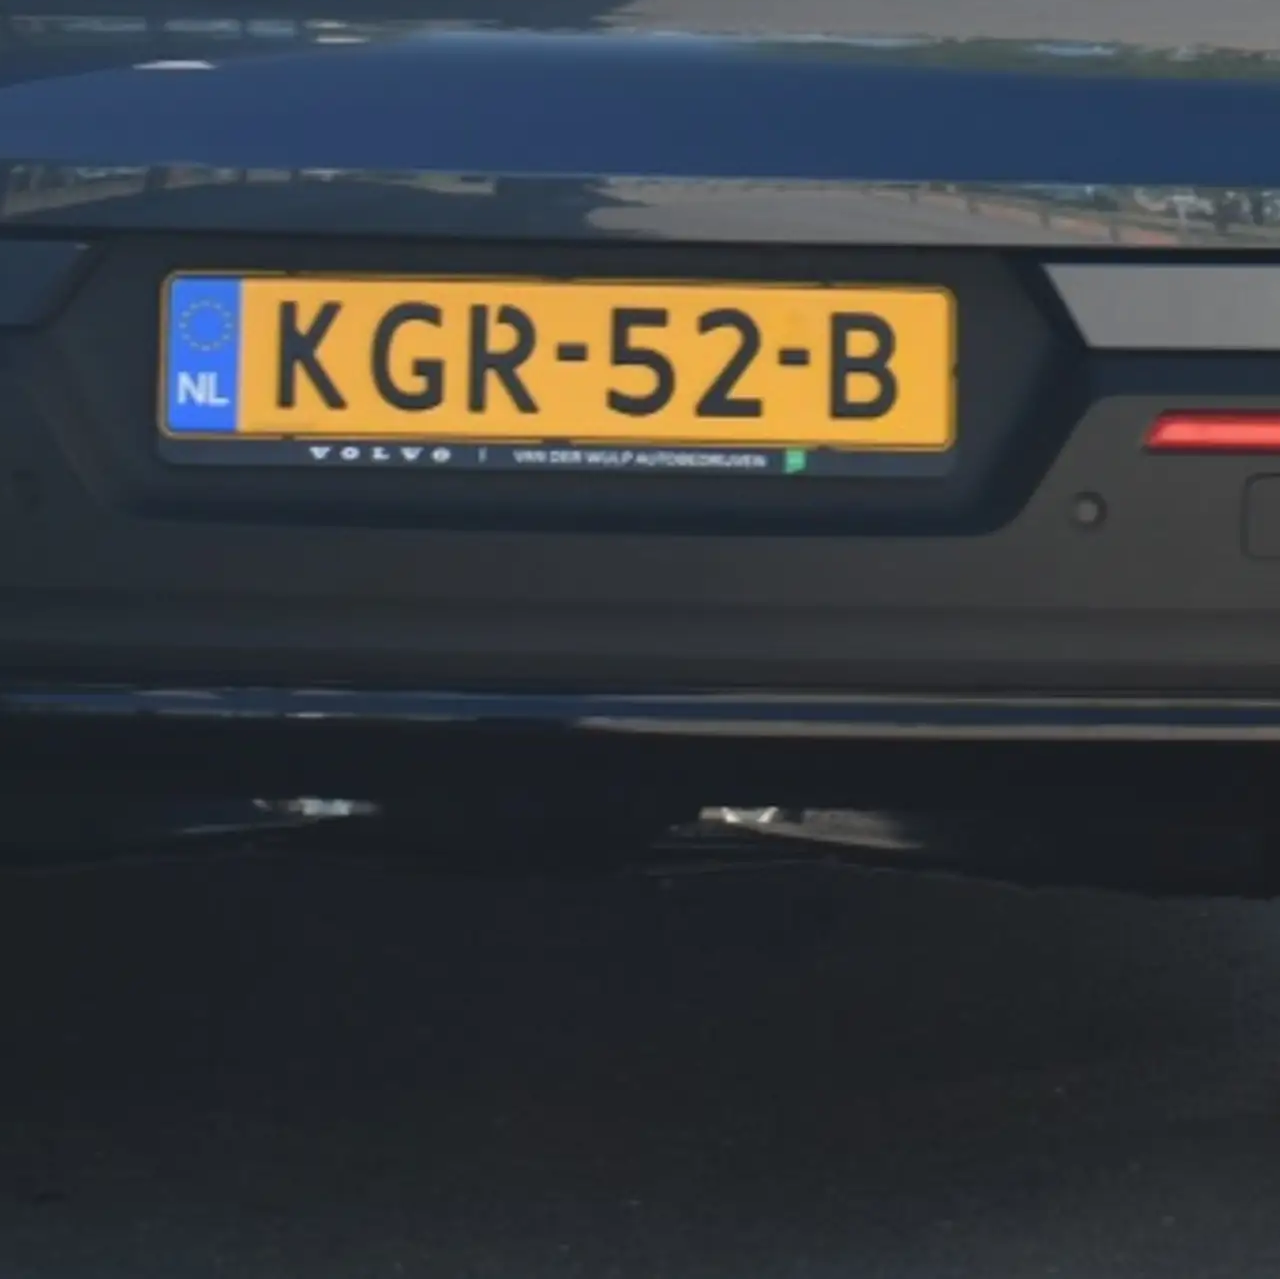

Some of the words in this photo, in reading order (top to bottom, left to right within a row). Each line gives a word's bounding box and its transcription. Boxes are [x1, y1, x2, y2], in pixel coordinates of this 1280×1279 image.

[275, 299, 898, 420] KGR-52-B
[176, 371, 230, 406] NL
[309, 445, 452, 464] VOLVO
[513, 449, 545, 464] VAN
[549, 449, 582, 464] DER
